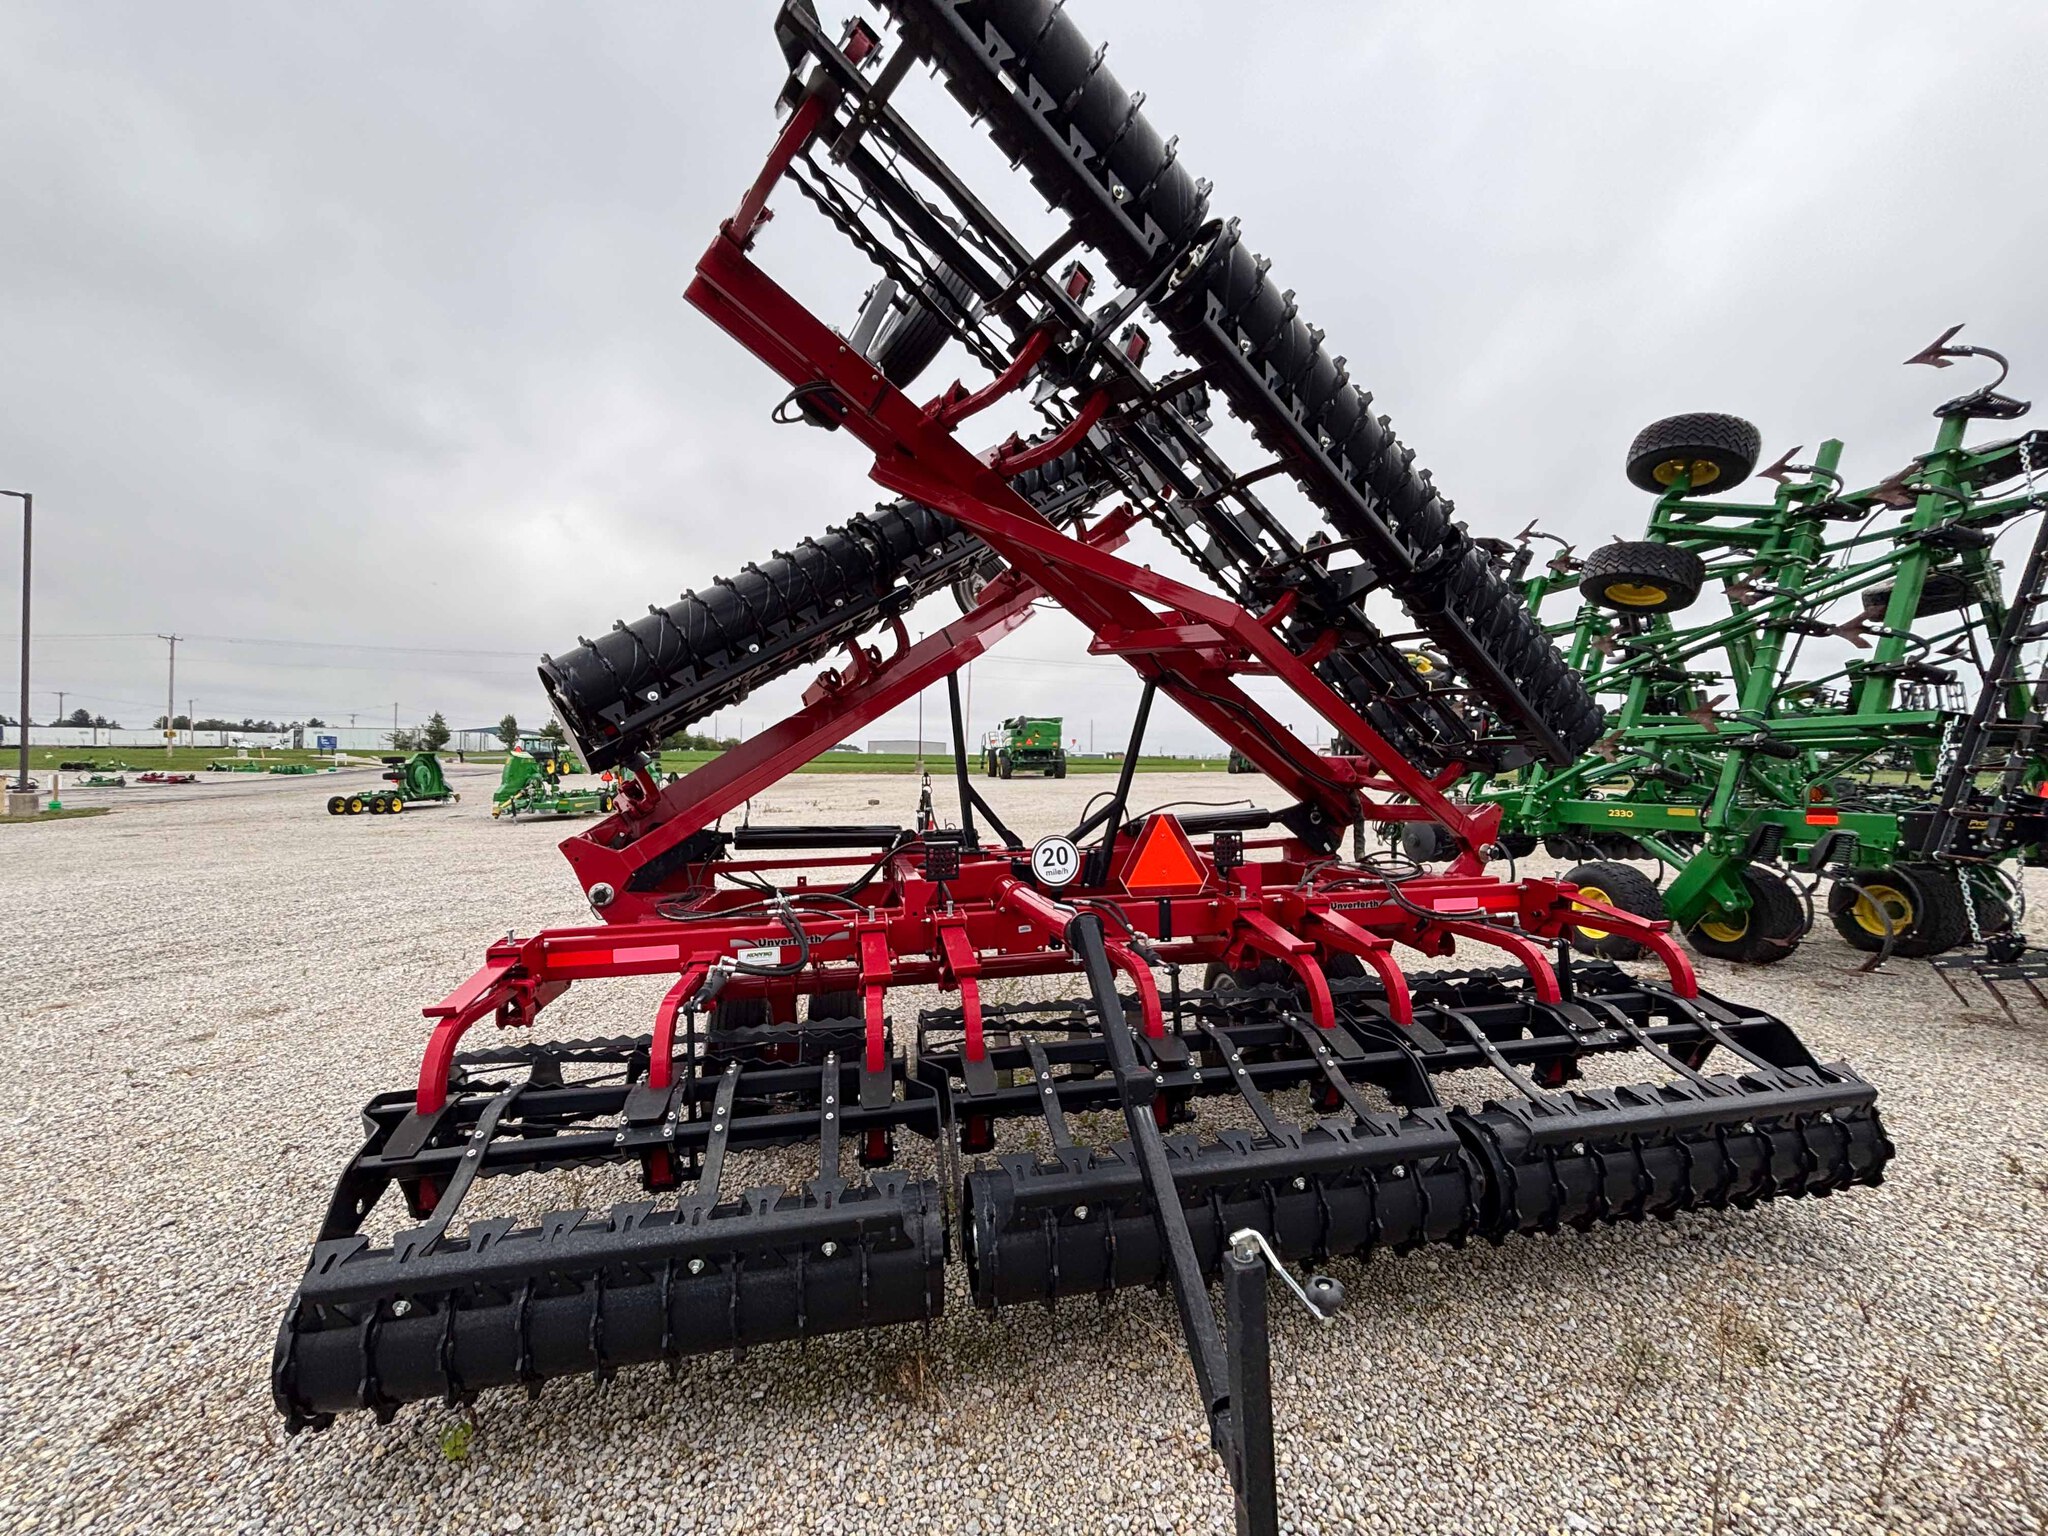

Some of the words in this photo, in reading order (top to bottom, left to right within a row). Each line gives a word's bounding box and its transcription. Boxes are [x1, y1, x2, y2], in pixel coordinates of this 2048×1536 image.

[1608, 809, 1633, 817] 2330
[1042, 846, 1069, 867] 20
[1045, 868, 1069, 876] mile/h
[758, 934, 822, 947] Unverfth
